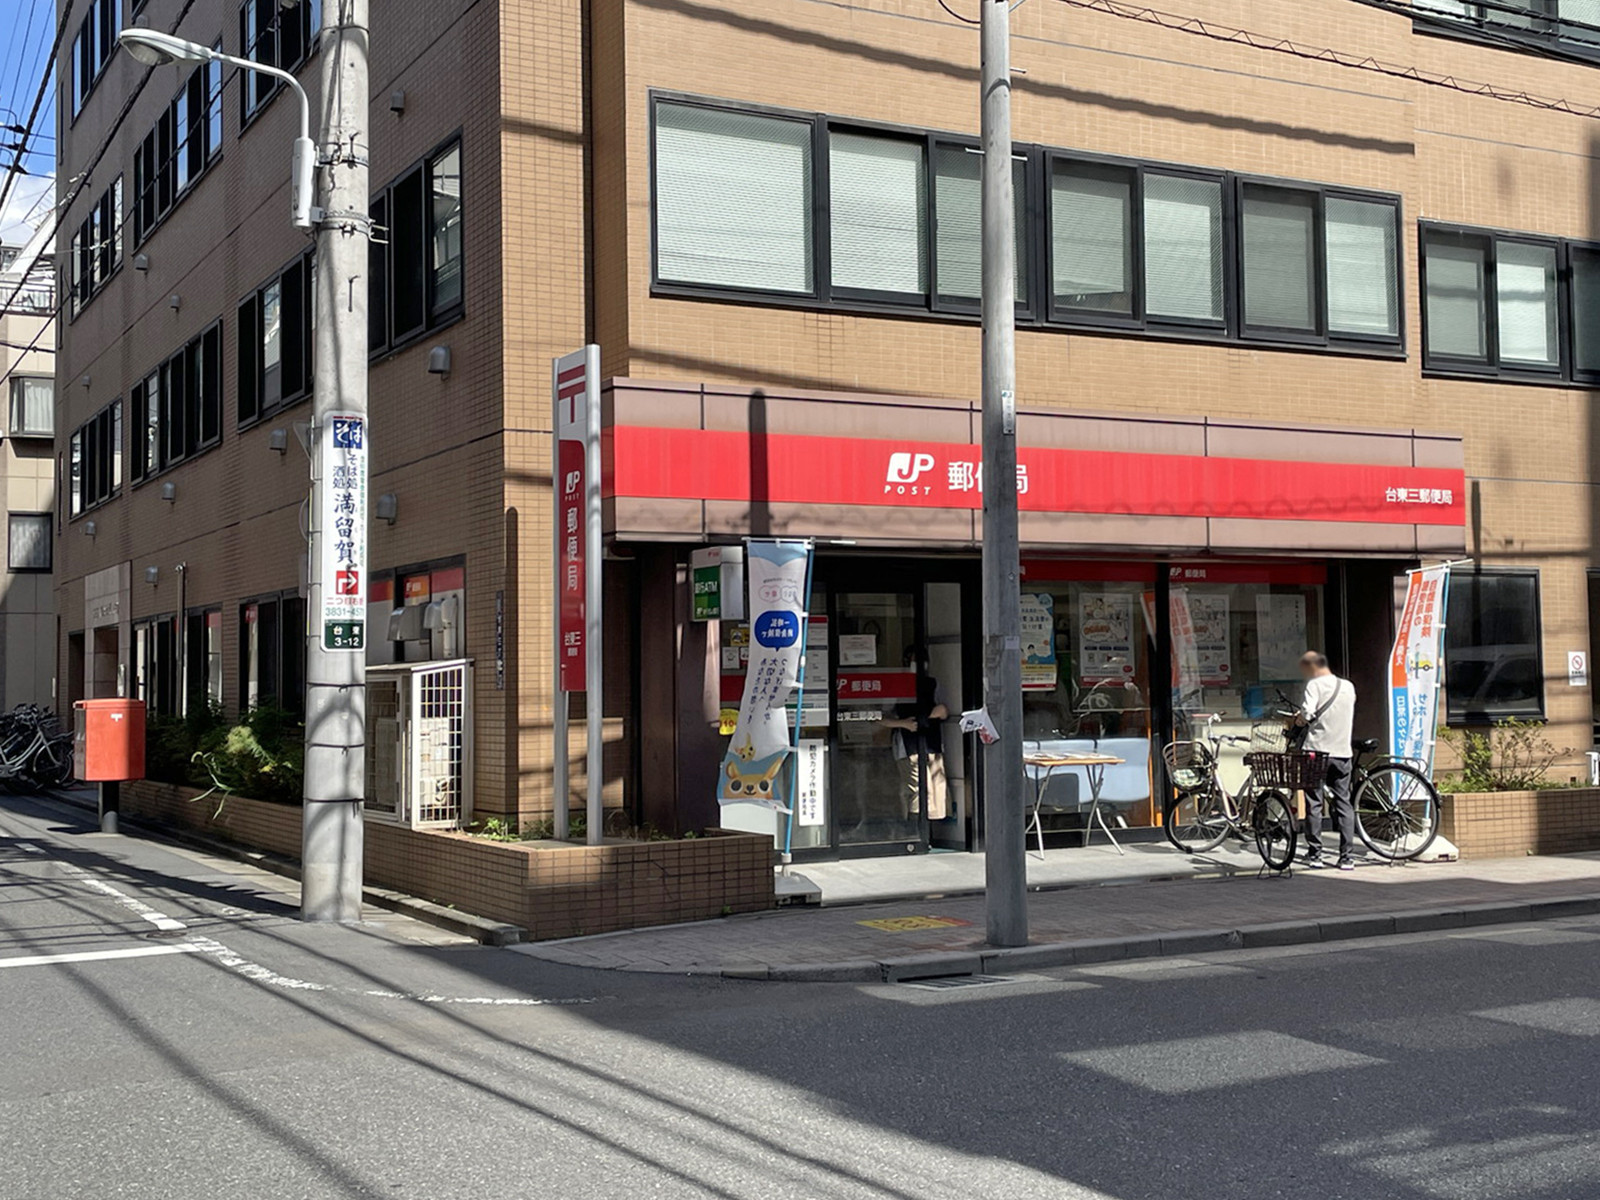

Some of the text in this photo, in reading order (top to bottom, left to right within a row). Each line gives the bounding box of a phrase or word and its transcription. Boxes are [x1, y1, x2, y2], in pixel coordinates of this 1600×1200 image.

[335, 421, 362, 444] そば
[333, 465, 346, 490] 酒処
[347, 454, 357, 490] そば処
[884, 485, 931, 495] POST
[1385, 486, 1453, 505] 台東三郵便局
[334, 492, 355, 563] 満留賀
[334, 637, 360, 647] 3-12
[851, 680, 881, 692] 郵便局
